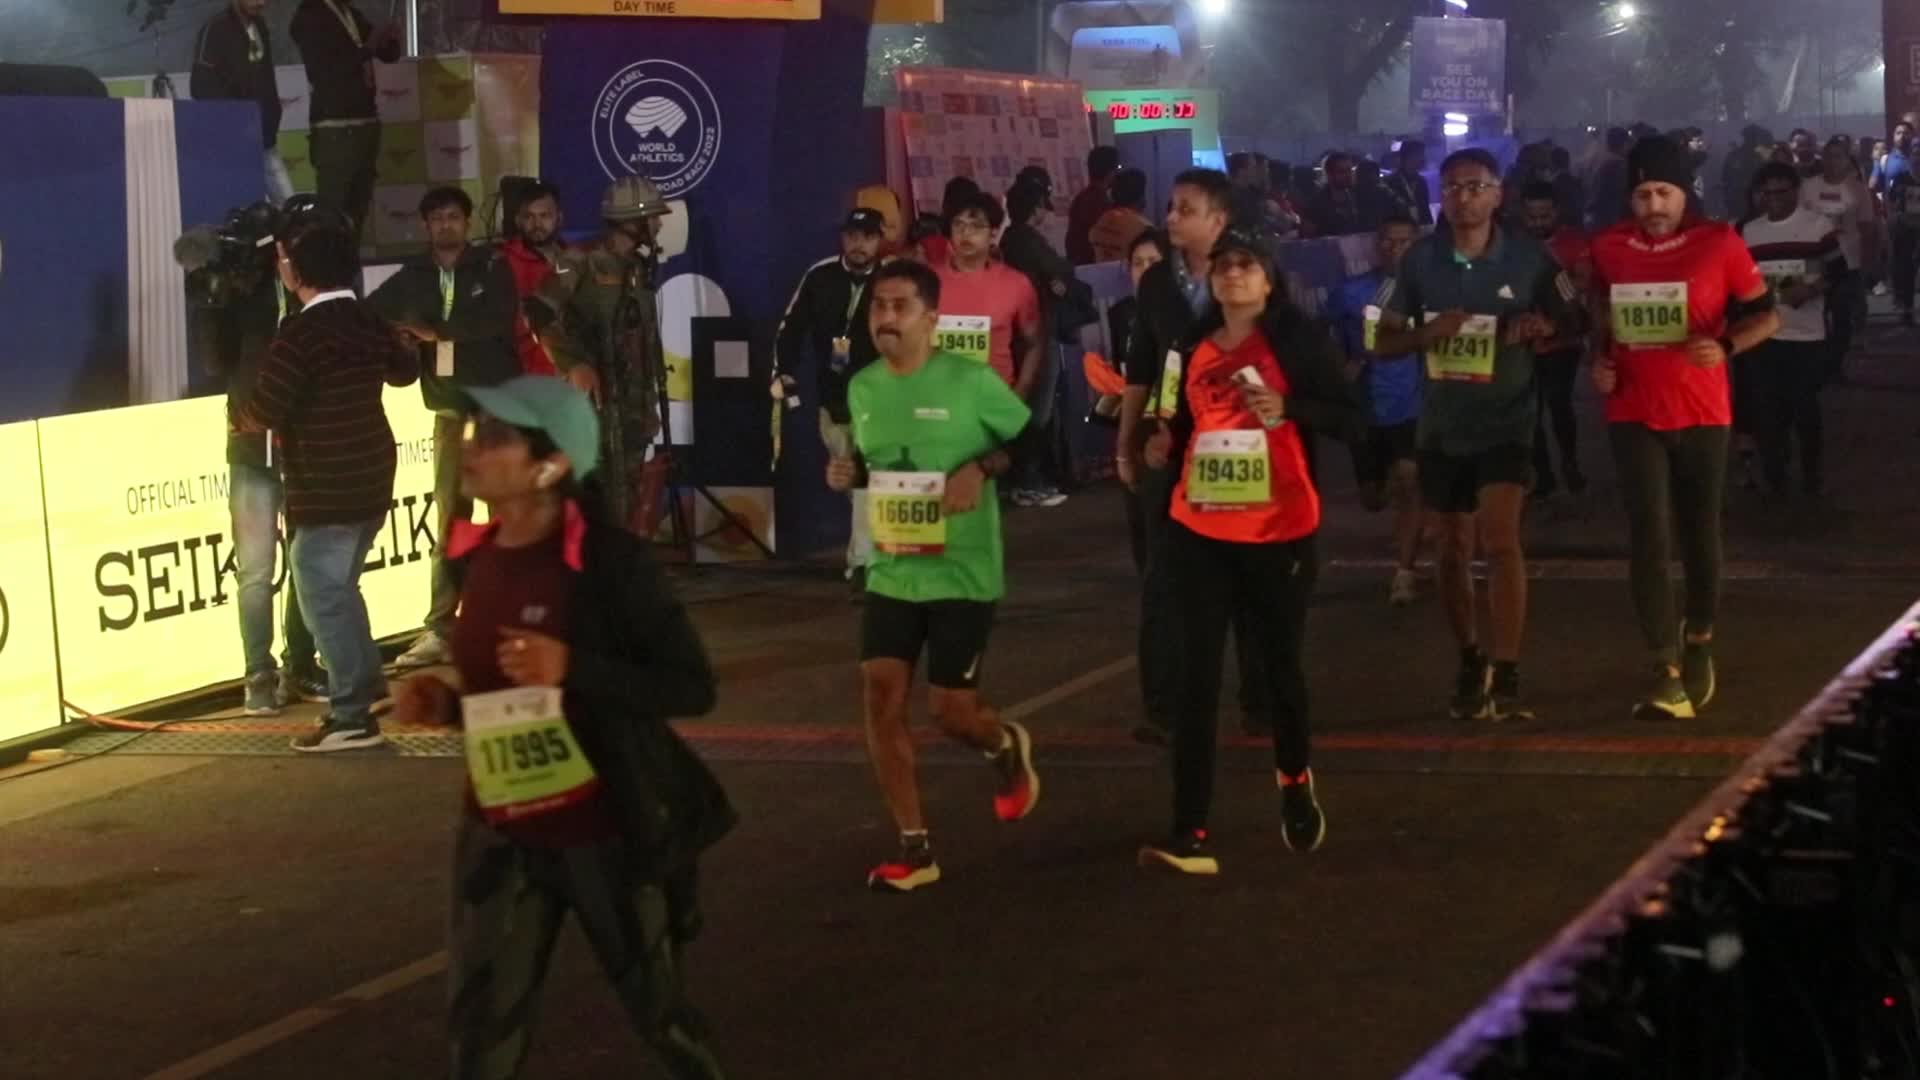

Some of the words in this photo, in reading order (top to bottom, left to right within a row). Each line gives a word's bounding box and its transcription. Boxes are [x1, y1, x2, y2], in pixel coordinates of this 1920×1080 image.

[613, 0, 640, 12] DAY
[644, 1, 675, 14] TIME
[1446, 64, 1473, 75] SEE
[600, 89, 618, 119] ELITE
[613, 69, 645, 92] LABEL
[1422, 88, 1461, 99] RACE
[1465, 89, 1497, 100] DAY
[1432, 77, 1461, 88] YOU
[1465, 77, 1488, 88] ON
[629, 153, 685, 163] ATHLETICS
[638, 142, 677, 152] WORLD
[656, 178, 685, 192] ROAD
[684, 156, 708, 182] RACE
[1620, 305, 1683, 328] 18104
[937, 332, 987, 351] 19416
[1196, 457, 1266, 483] 19438
[126, 477, 197, 516] OFFICIAL
[198, 471, 230, 504] TIM
[876, 500, 940, 524] 16660
[94, 532, 287, 633] SEIK
[479, 725, 572, 775] 17995
